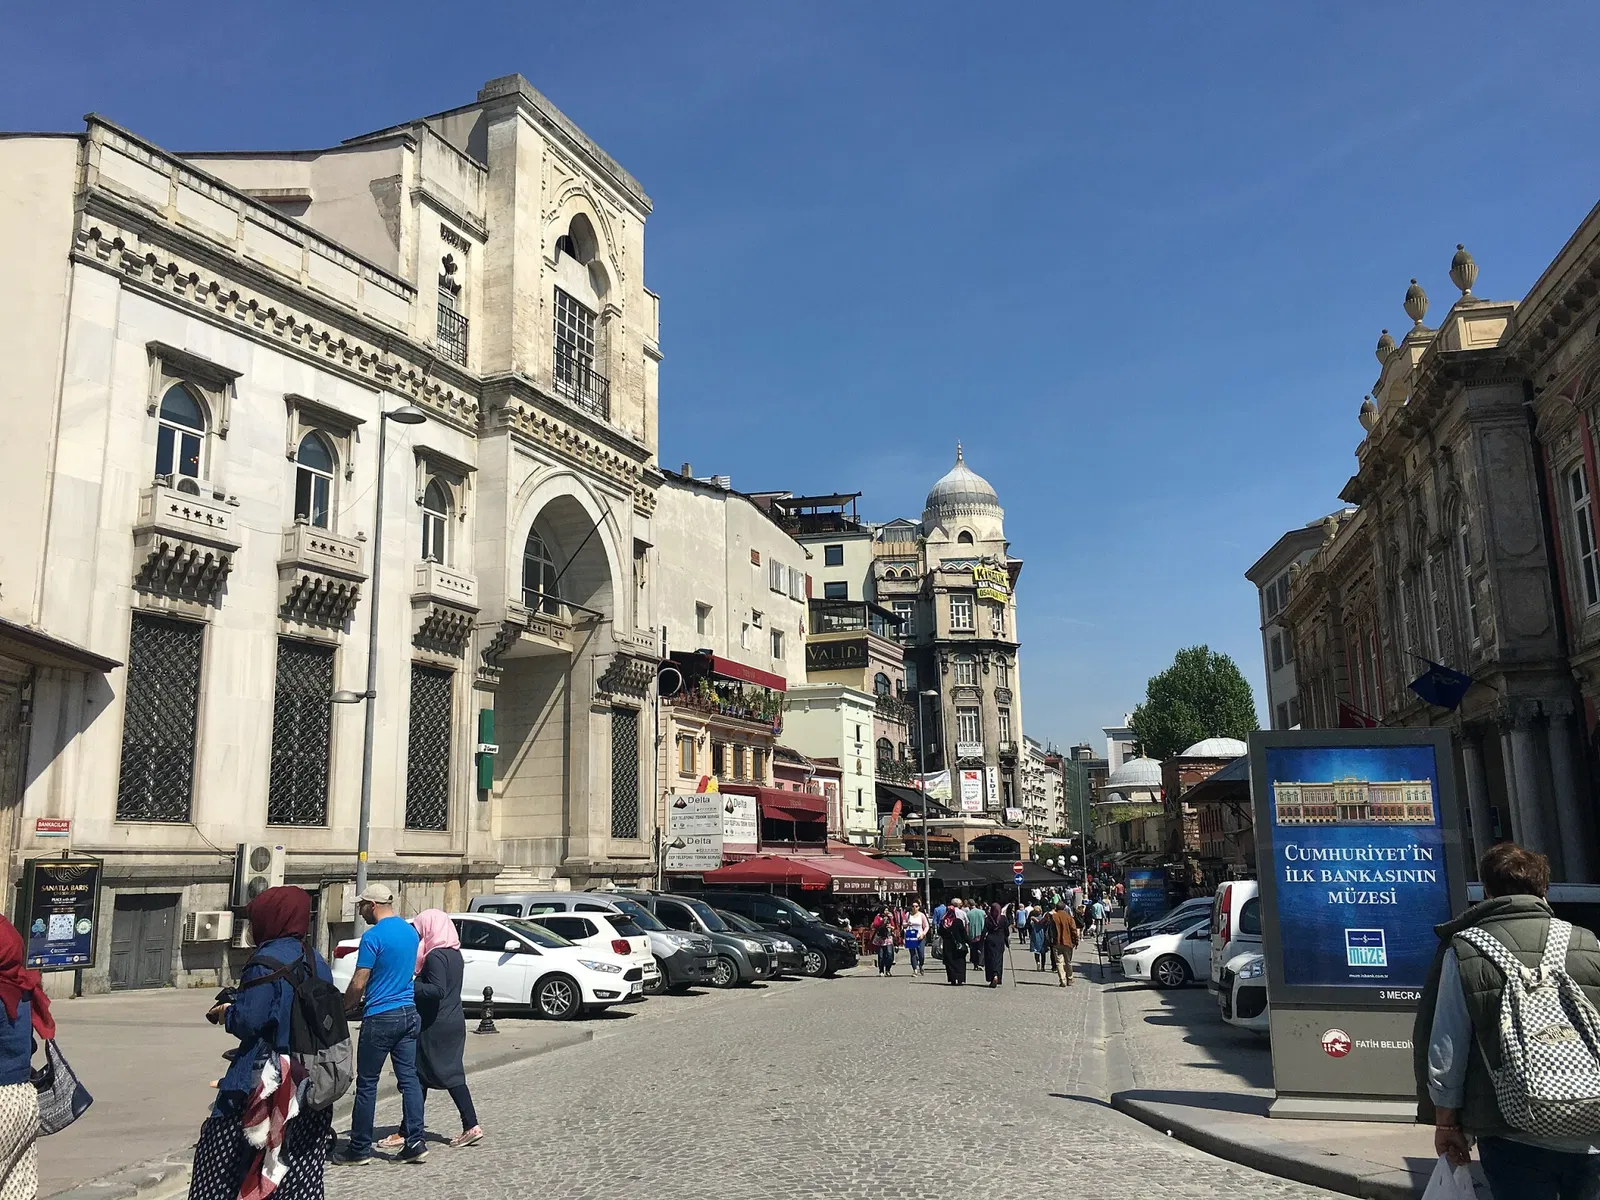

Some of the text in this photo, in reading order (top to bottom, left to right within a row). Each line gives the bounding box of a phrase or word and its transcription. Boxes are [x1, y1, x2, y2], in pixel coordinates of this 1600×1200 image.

[988, 768, 997, 799] YILDIZ
[734, 798, 748, 809] Delta
[1284, 866, 1437, 883] İLK BANKASININ
[70, 884, 89, 892] BARIŞ
[1328, 886, 1398, 905] MÜZESİ
[1349, 948, 1385, 964] MÜZE
[1380, 991, 1421, 1000] 3 MECRA
[1356, 1038, 1379, 1049] FATİH
